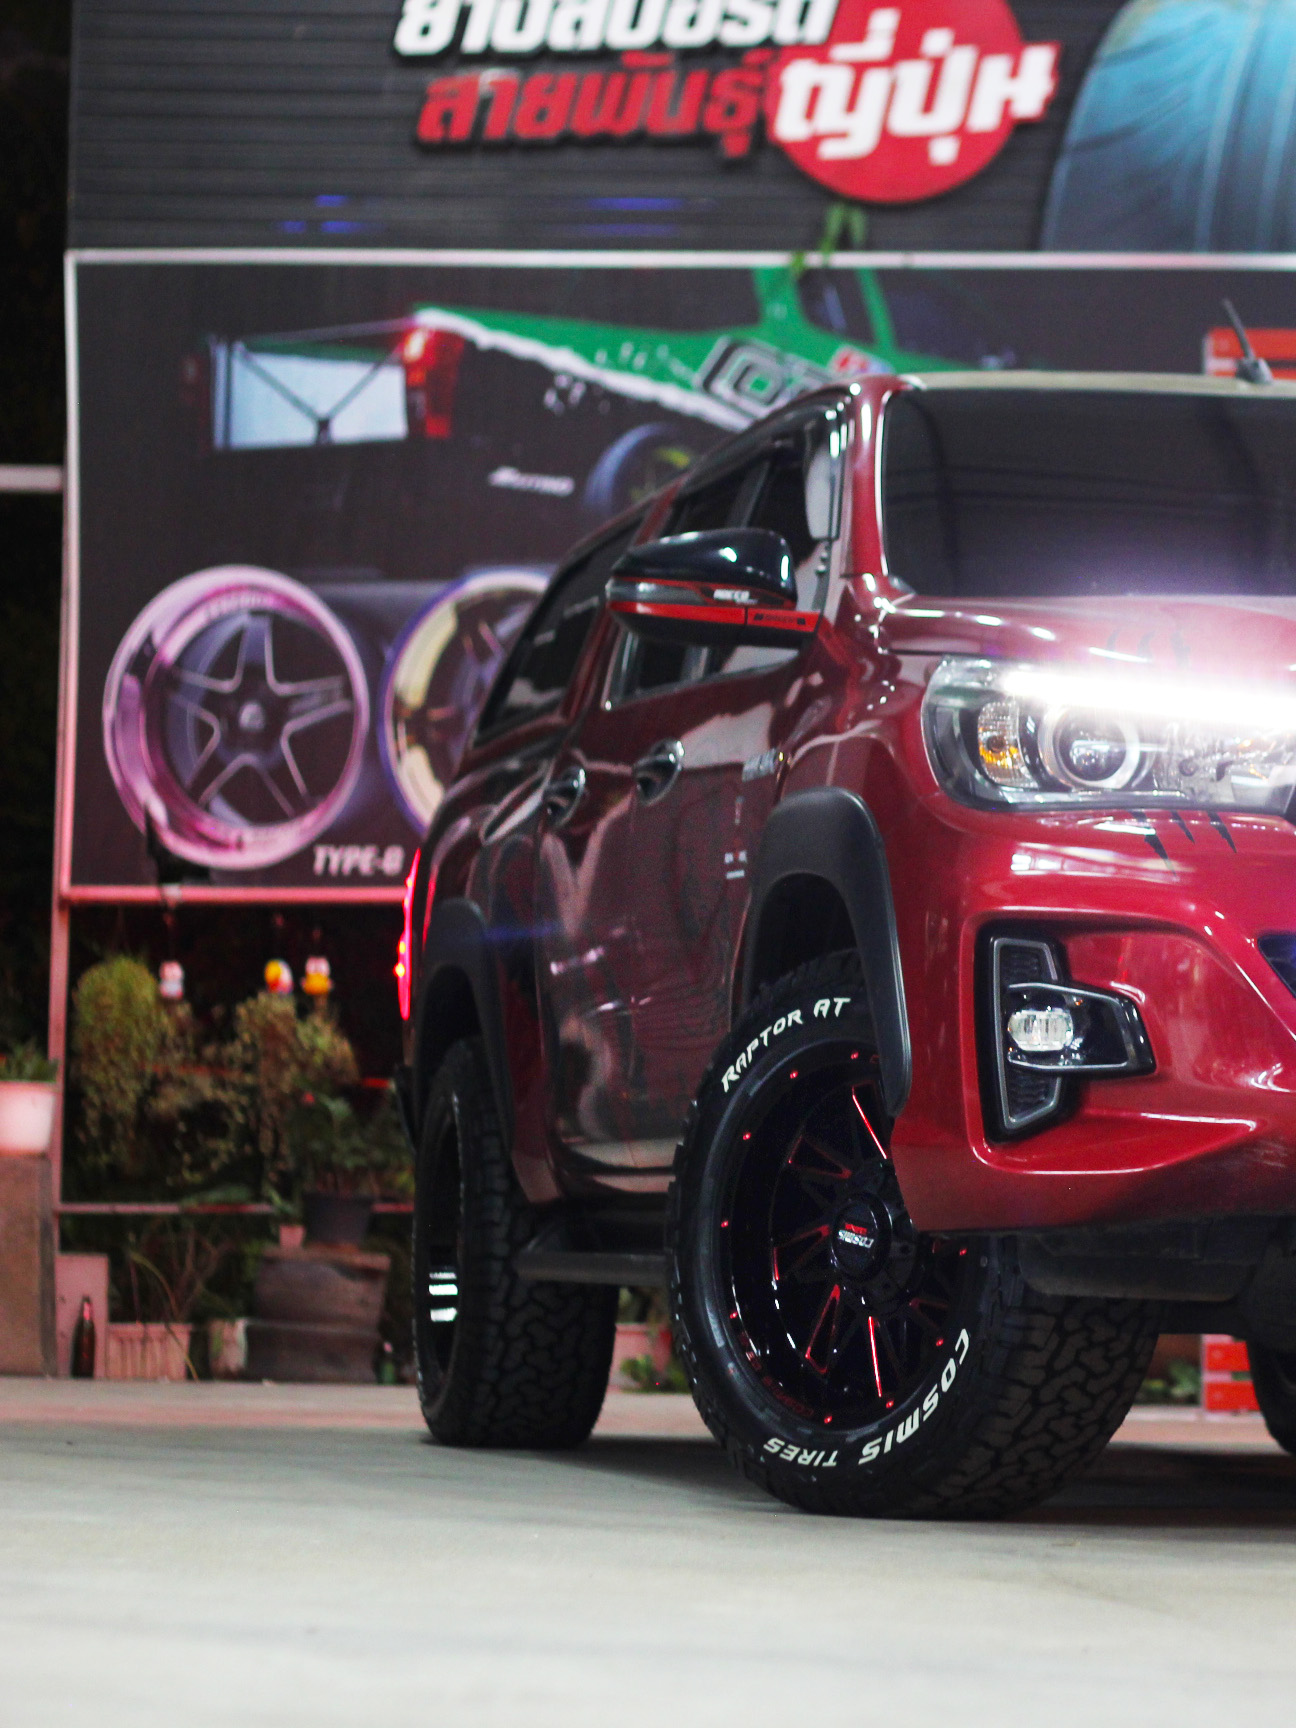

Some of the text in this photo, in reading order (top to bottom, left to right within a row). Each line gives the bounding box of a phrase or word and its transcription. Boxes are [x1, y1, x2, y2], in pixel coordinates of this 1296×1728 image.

[721, 997, 851, 1093] RAPTOR AT
[858, 1329, 970, 1465] COSMIS
[763, 1437, 838, 1467] TIRES
